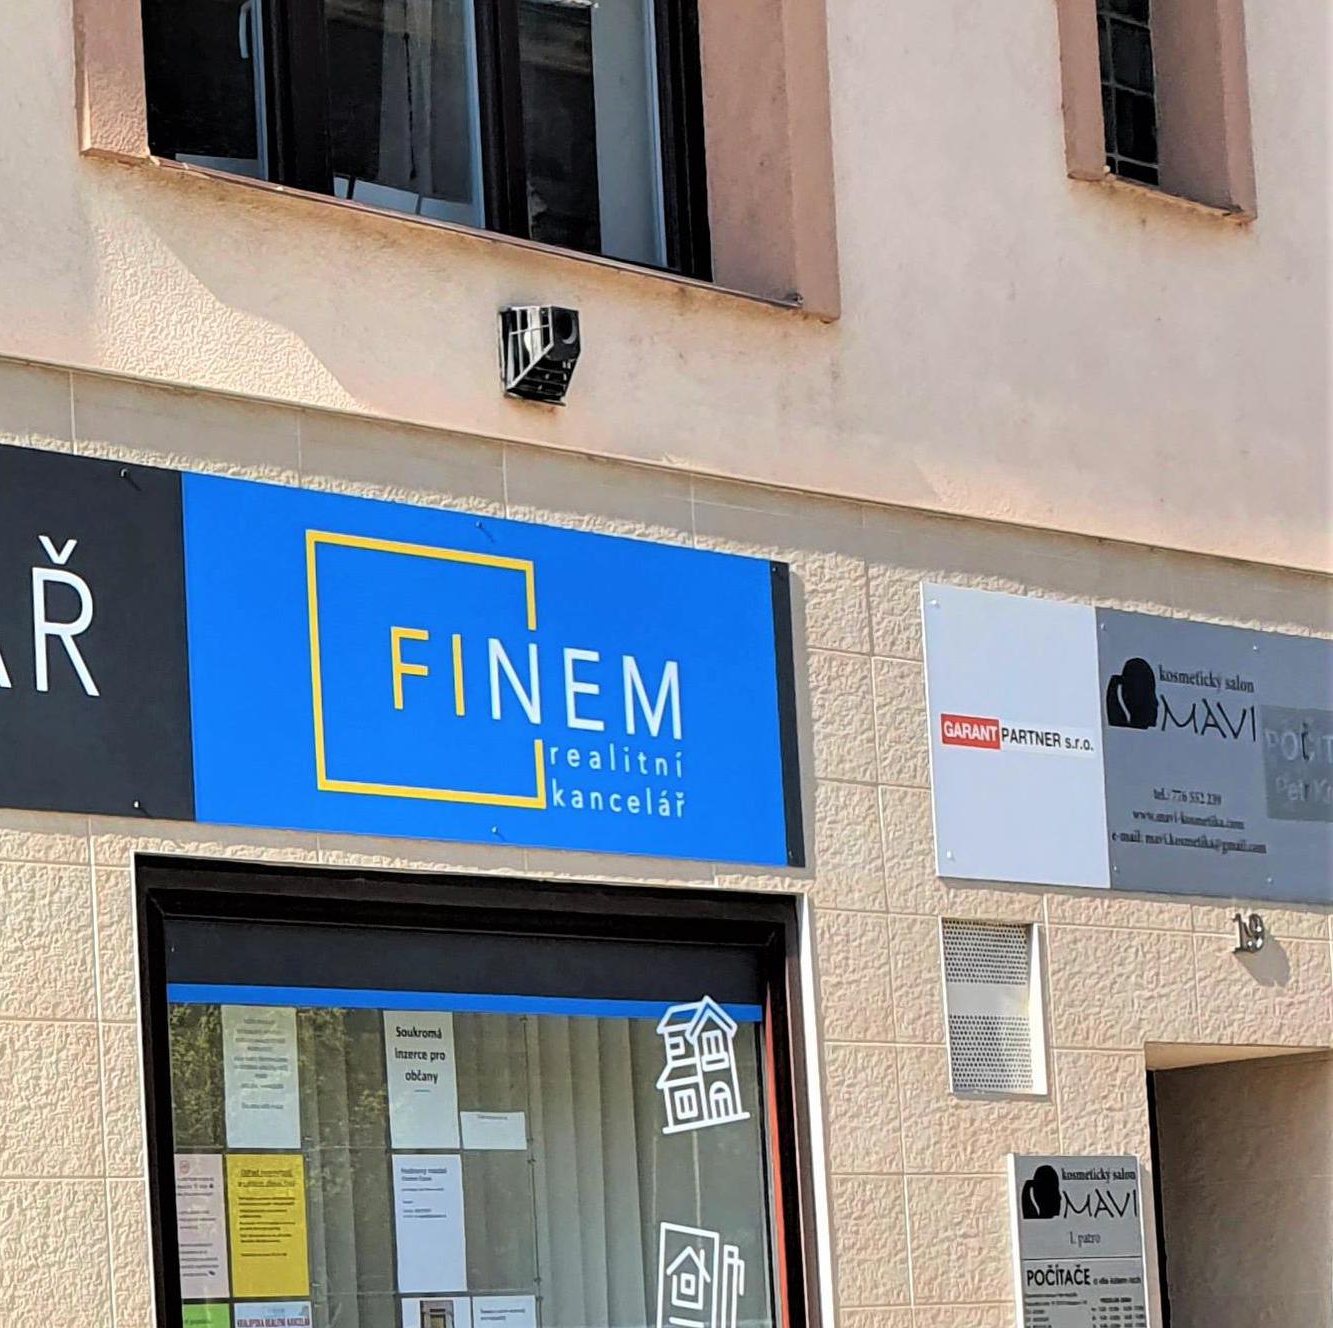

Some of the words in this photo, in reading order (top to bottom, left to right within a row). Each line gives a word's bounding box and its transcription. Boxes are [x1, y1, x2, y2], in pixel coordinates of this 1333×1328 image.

[390, 625, 683, 740] FINEM
[1225, 675, 1254, 693] salon
[1160, 693, 1256, 742] MAVI
[943, 720, 998, 742] GARANT
[1001, 727, 1062, 748] PARTNER
[1065, 738, 1094, 751] s.r.o.
[549, 743, 682, 778] realitní
[552, 778, 685, 818] kancelář
[395, 1026, 442, 1039] Soukromá
[430, 1051, 446, 1062] pro
[405, 1069, 439, 1085] občany
[1113, 1167, 1136, 1181] salon
[1062, 1188, 1138, 1219] MAVI
[1026, 1263, 1091, 1287] POČÍTAČE
